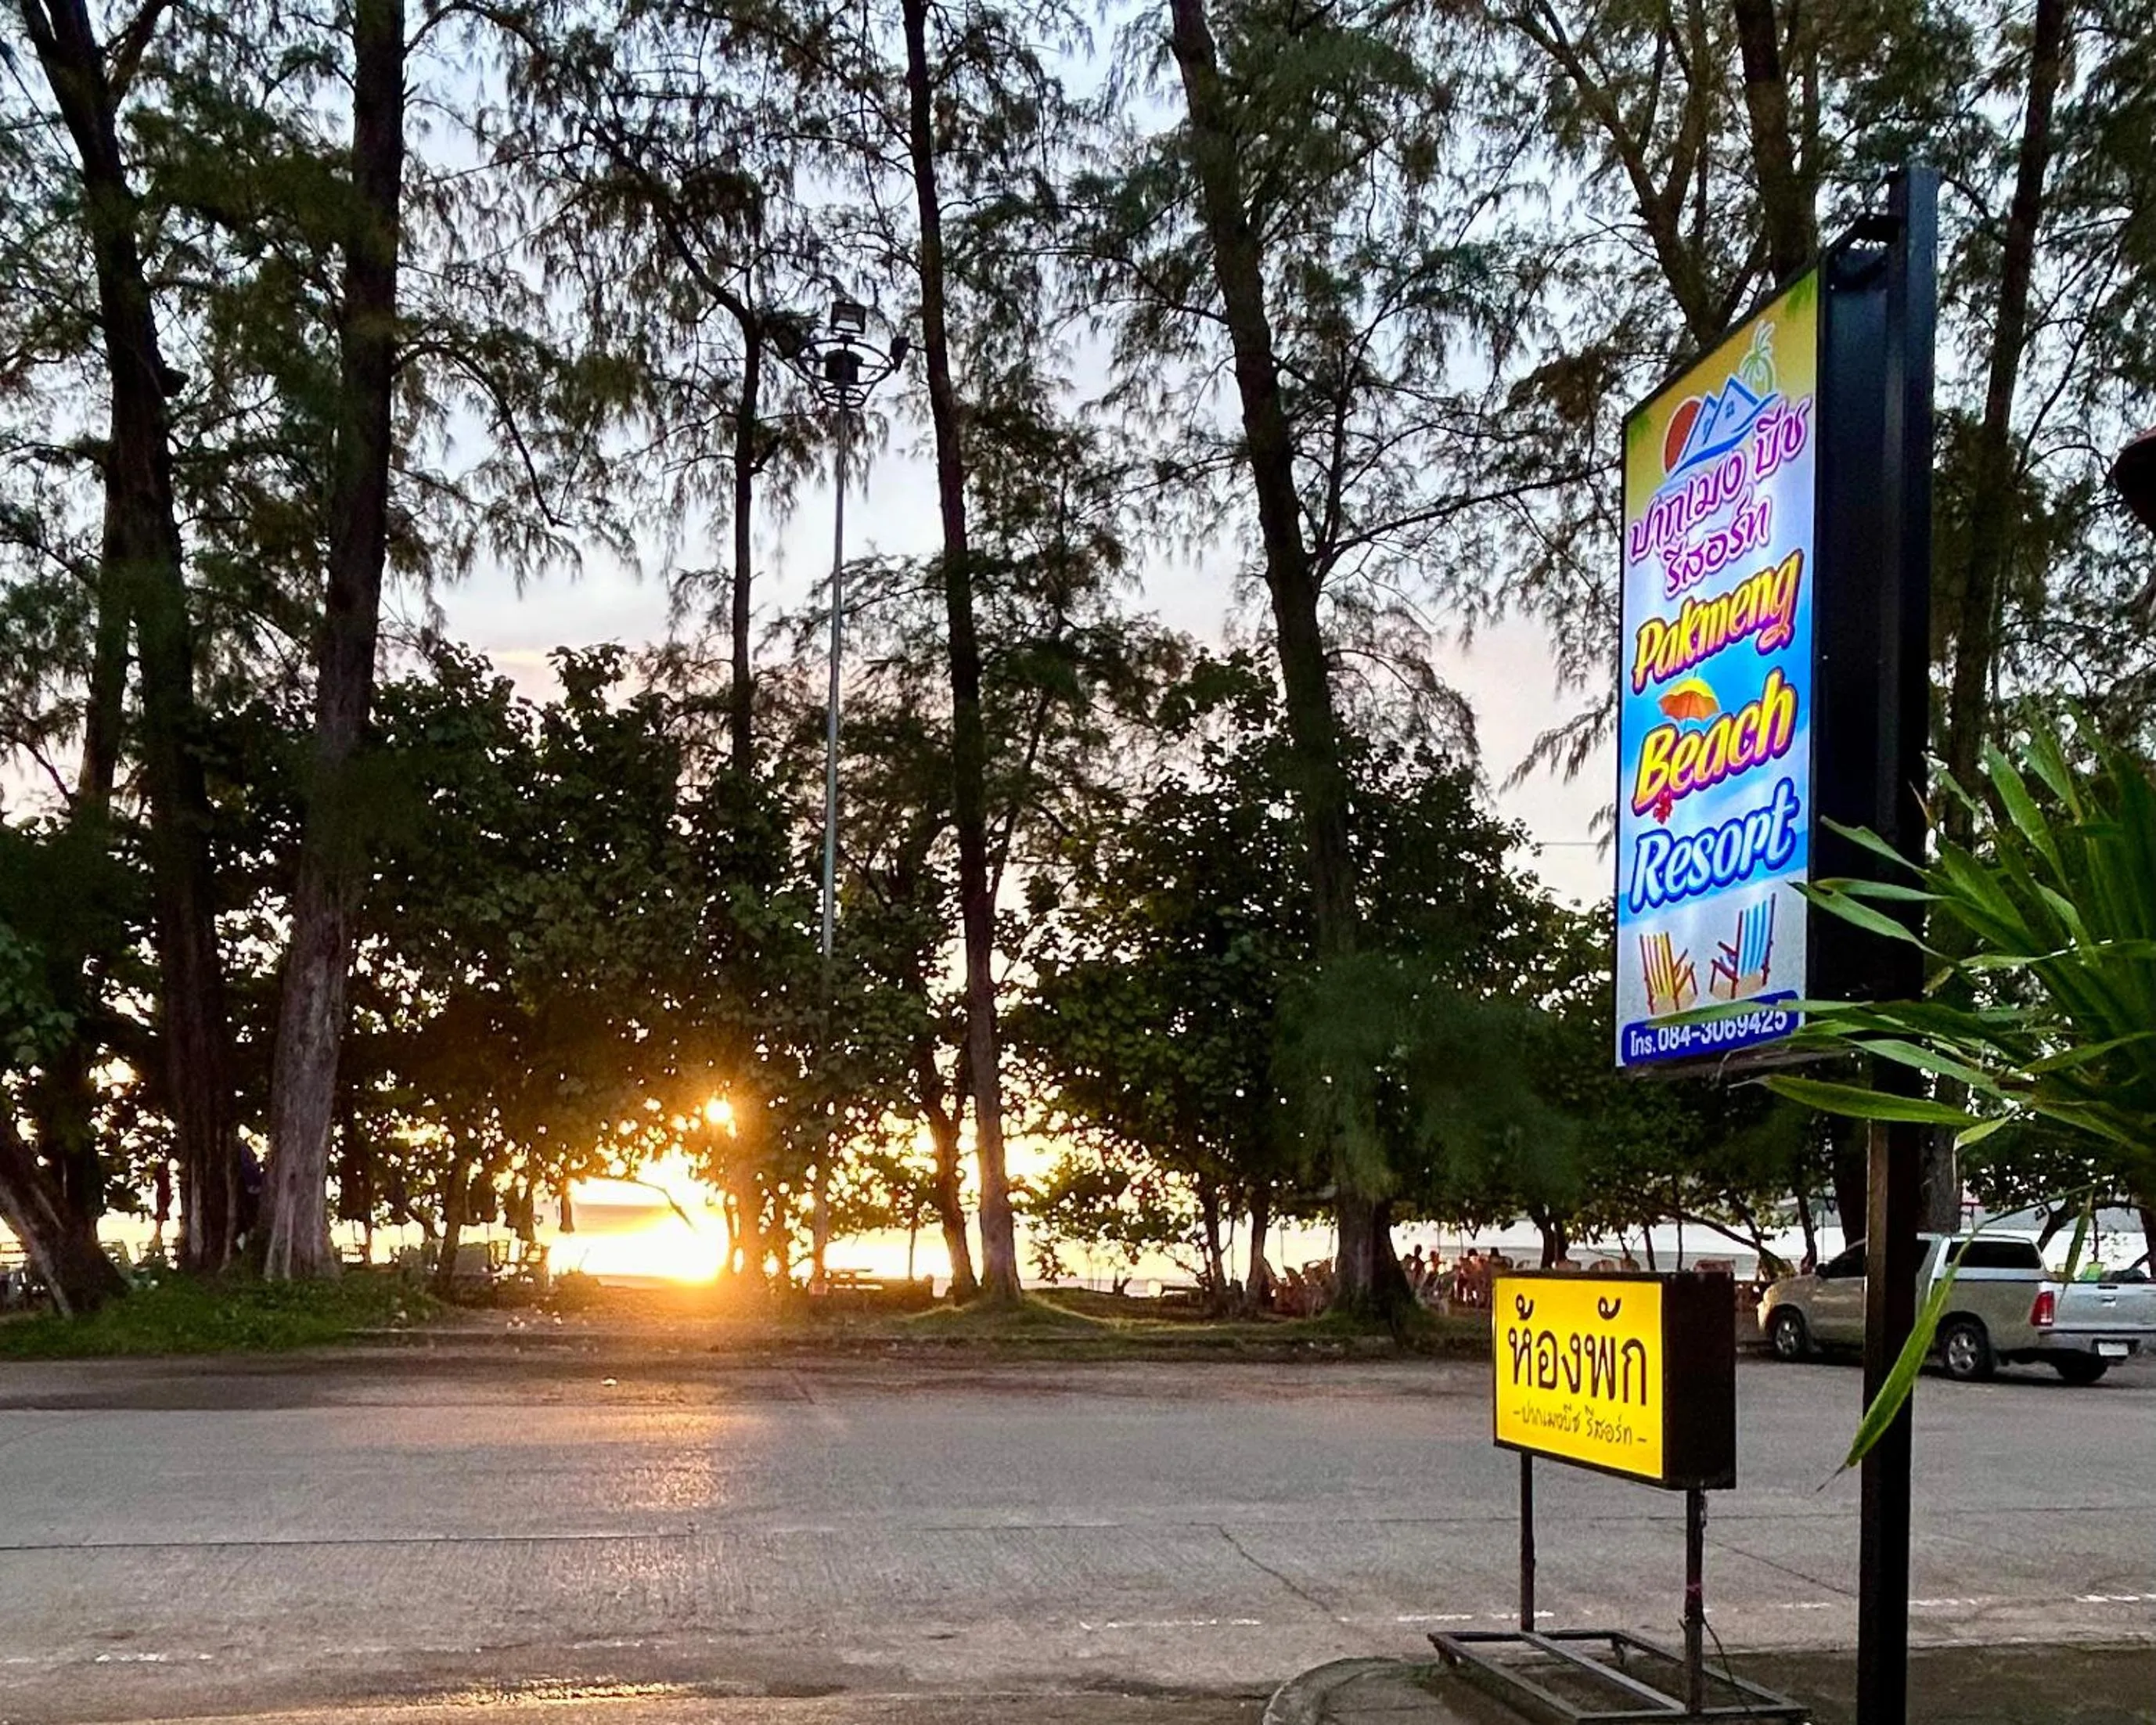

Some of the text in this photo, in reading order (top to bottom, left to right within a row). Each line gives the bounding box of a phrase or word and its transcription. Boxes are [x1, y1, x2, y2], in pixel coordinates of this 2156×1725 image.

[1630, 397, 1812, 563] ปากเมง บีช
[1662, 485, 1770, 598] รีสอร์ท
[1632, 549, 1803, 694] Pakmeng
[1632, 667, 1798, 816] Beach
[1629, 777, 1799, 913] Resort
[1508, 1294, 1647, 1406] ห้องพัก
